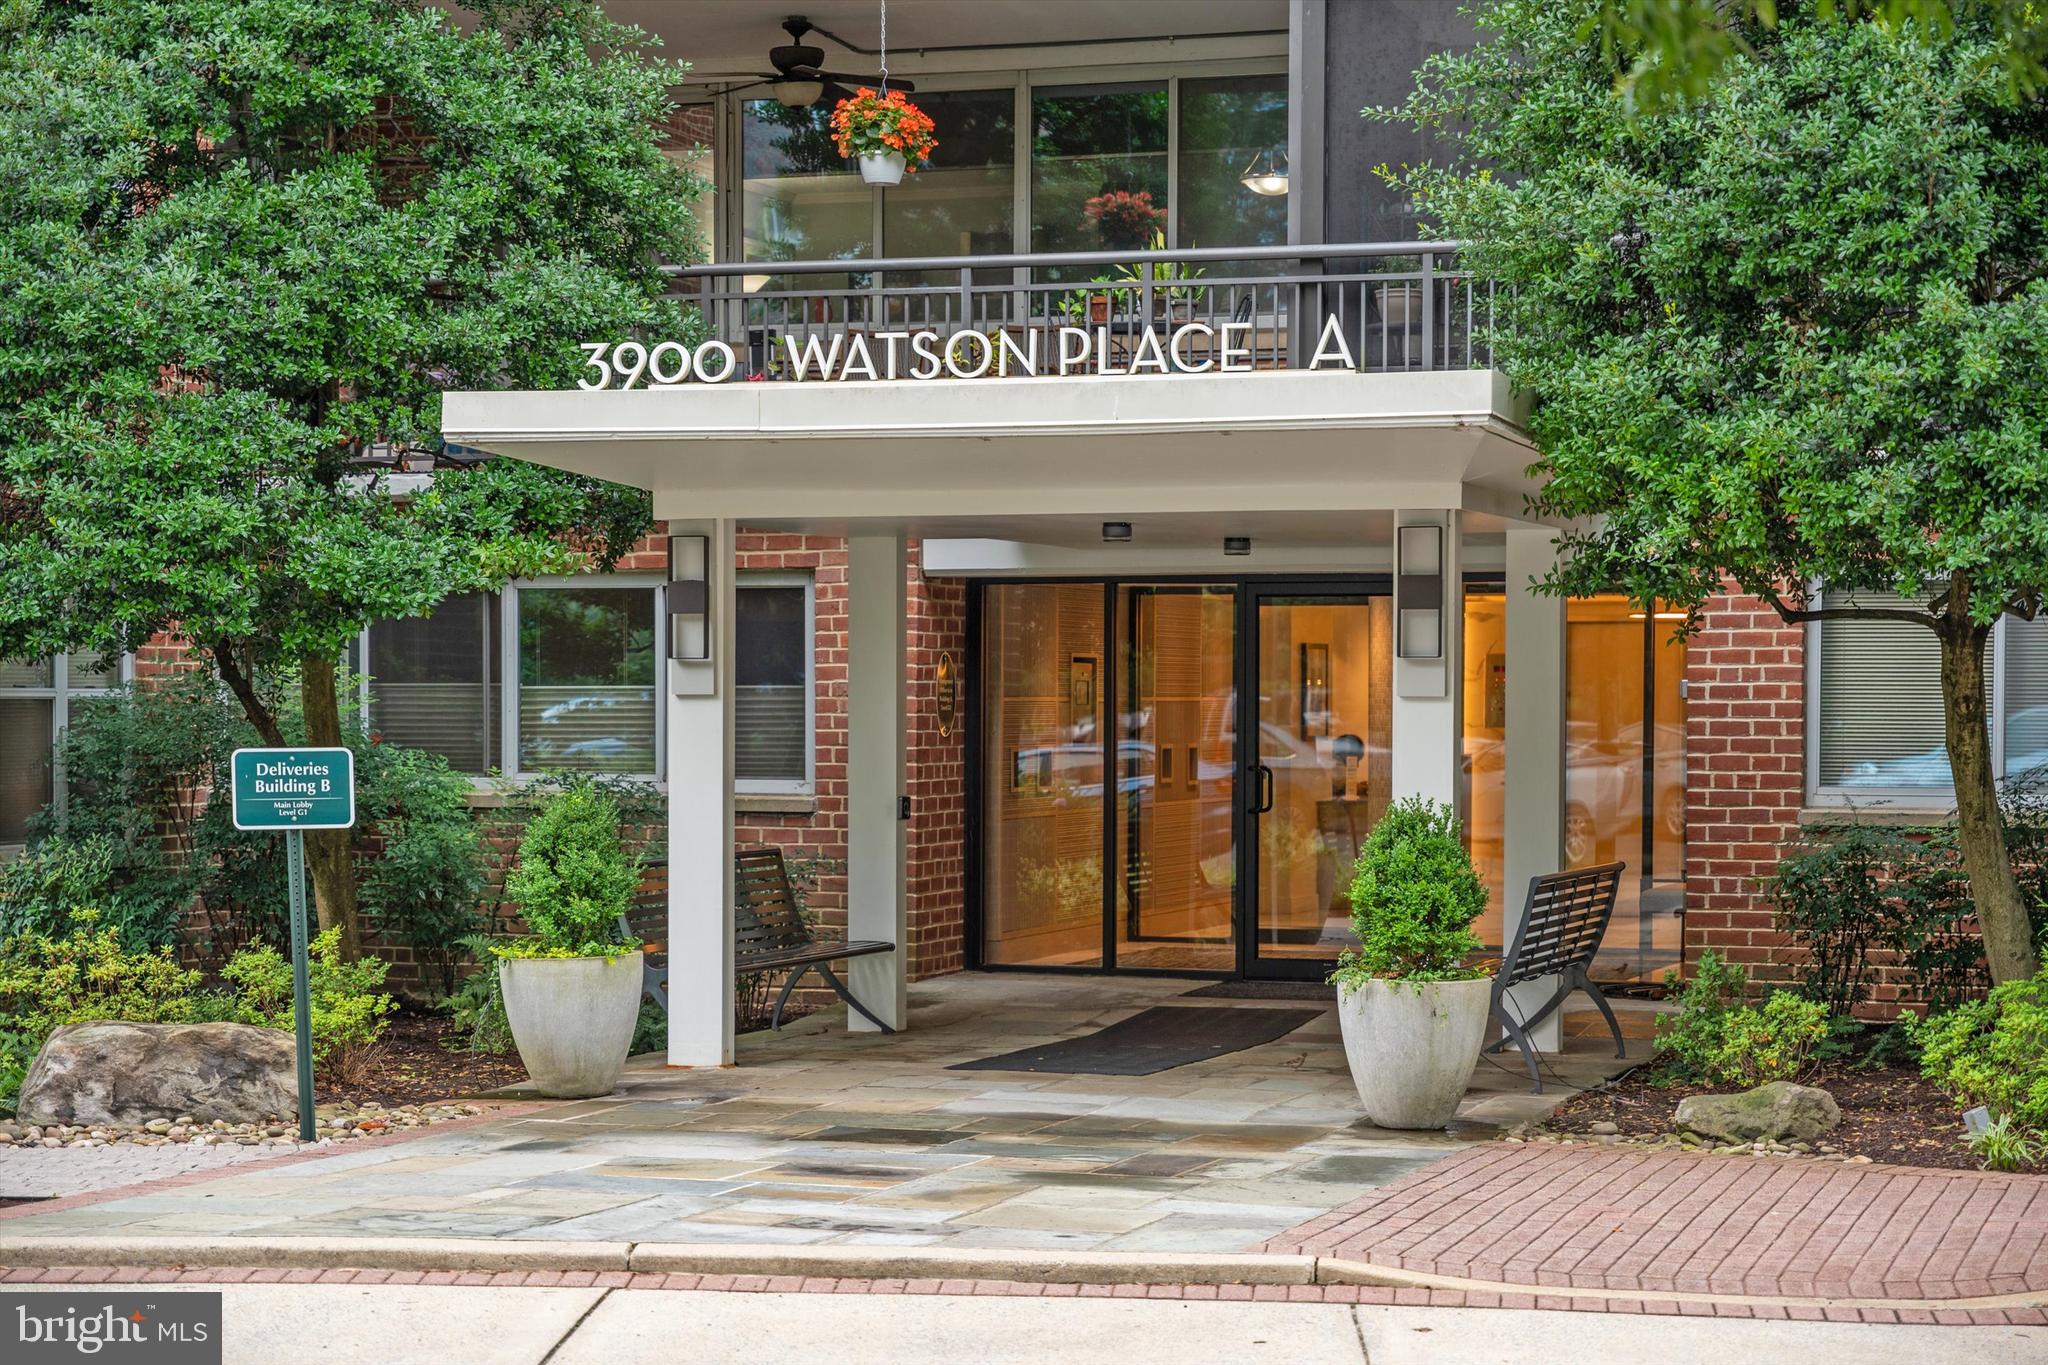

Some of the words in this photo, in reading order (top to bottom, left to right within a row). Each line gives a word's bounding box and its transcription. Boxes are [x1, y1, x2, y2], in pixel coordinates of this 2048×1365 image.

[577, 340, 736, 390] 3900
[785, 329, 1038, 382] WATSON
[1060, 322, 1252, 376] PLACE
[1309, 312, 1357, 370] A
[256, 762, 329, 776] Deliveries
[255, 779, 316, 795] Building
[321, 779, 331, 792] B
[293, 801, 313, 809] Lobby
